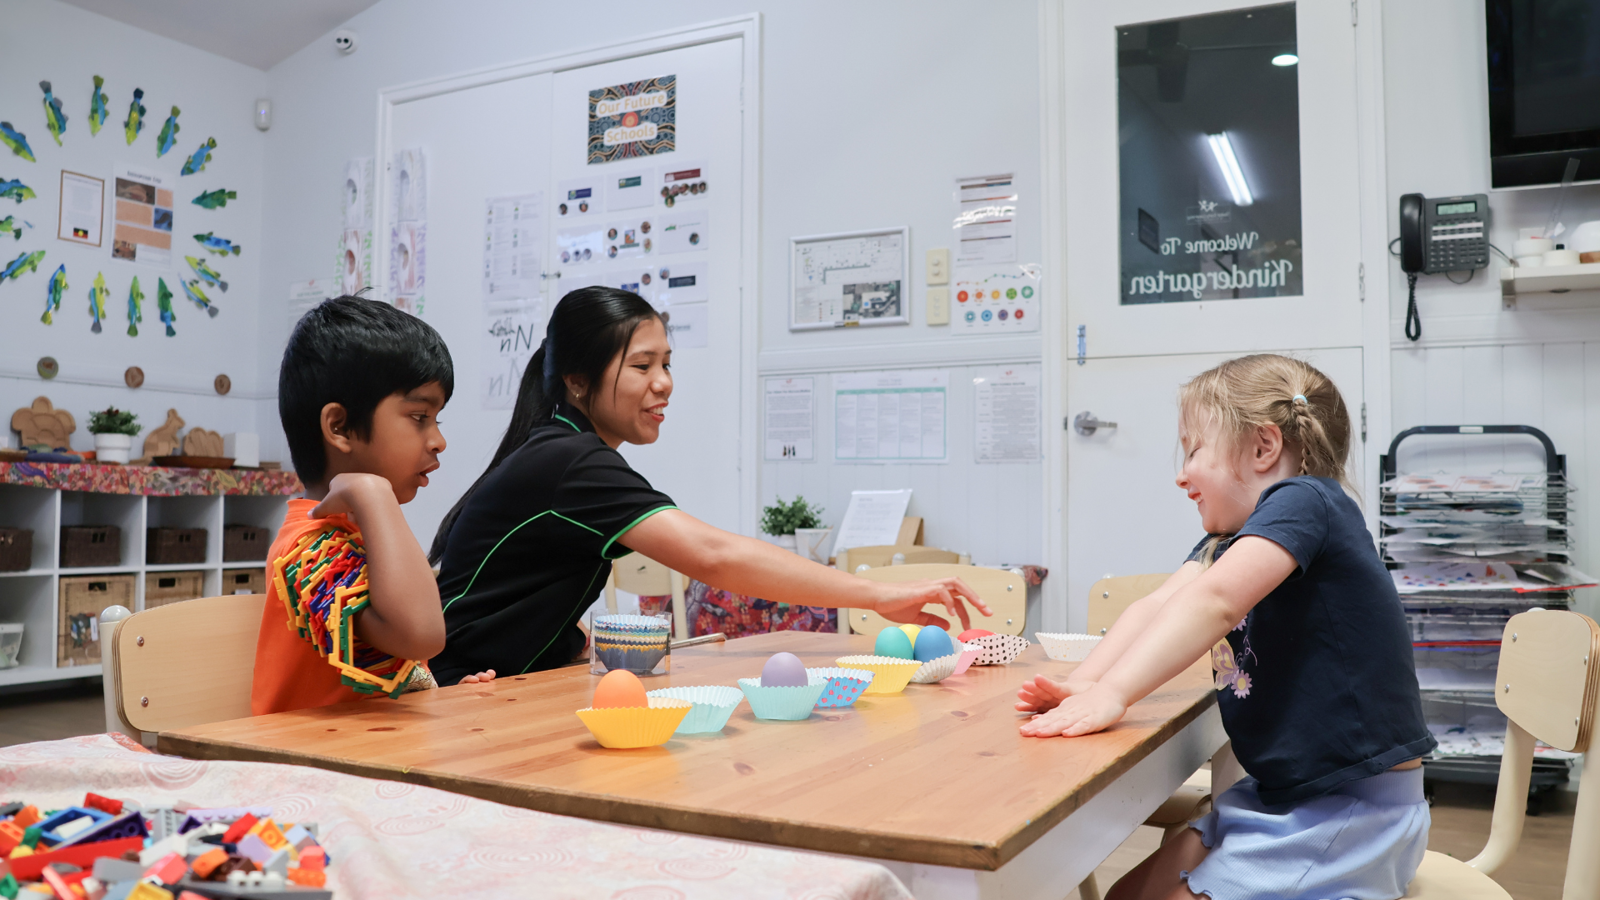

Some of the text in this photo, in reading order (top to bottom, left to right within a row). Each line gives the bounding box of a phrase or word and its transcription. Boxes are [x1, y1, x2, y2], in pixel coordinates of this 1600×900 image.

[598, 94, 665, 115] Our Future
[606, 125, 655, 143] Schools
